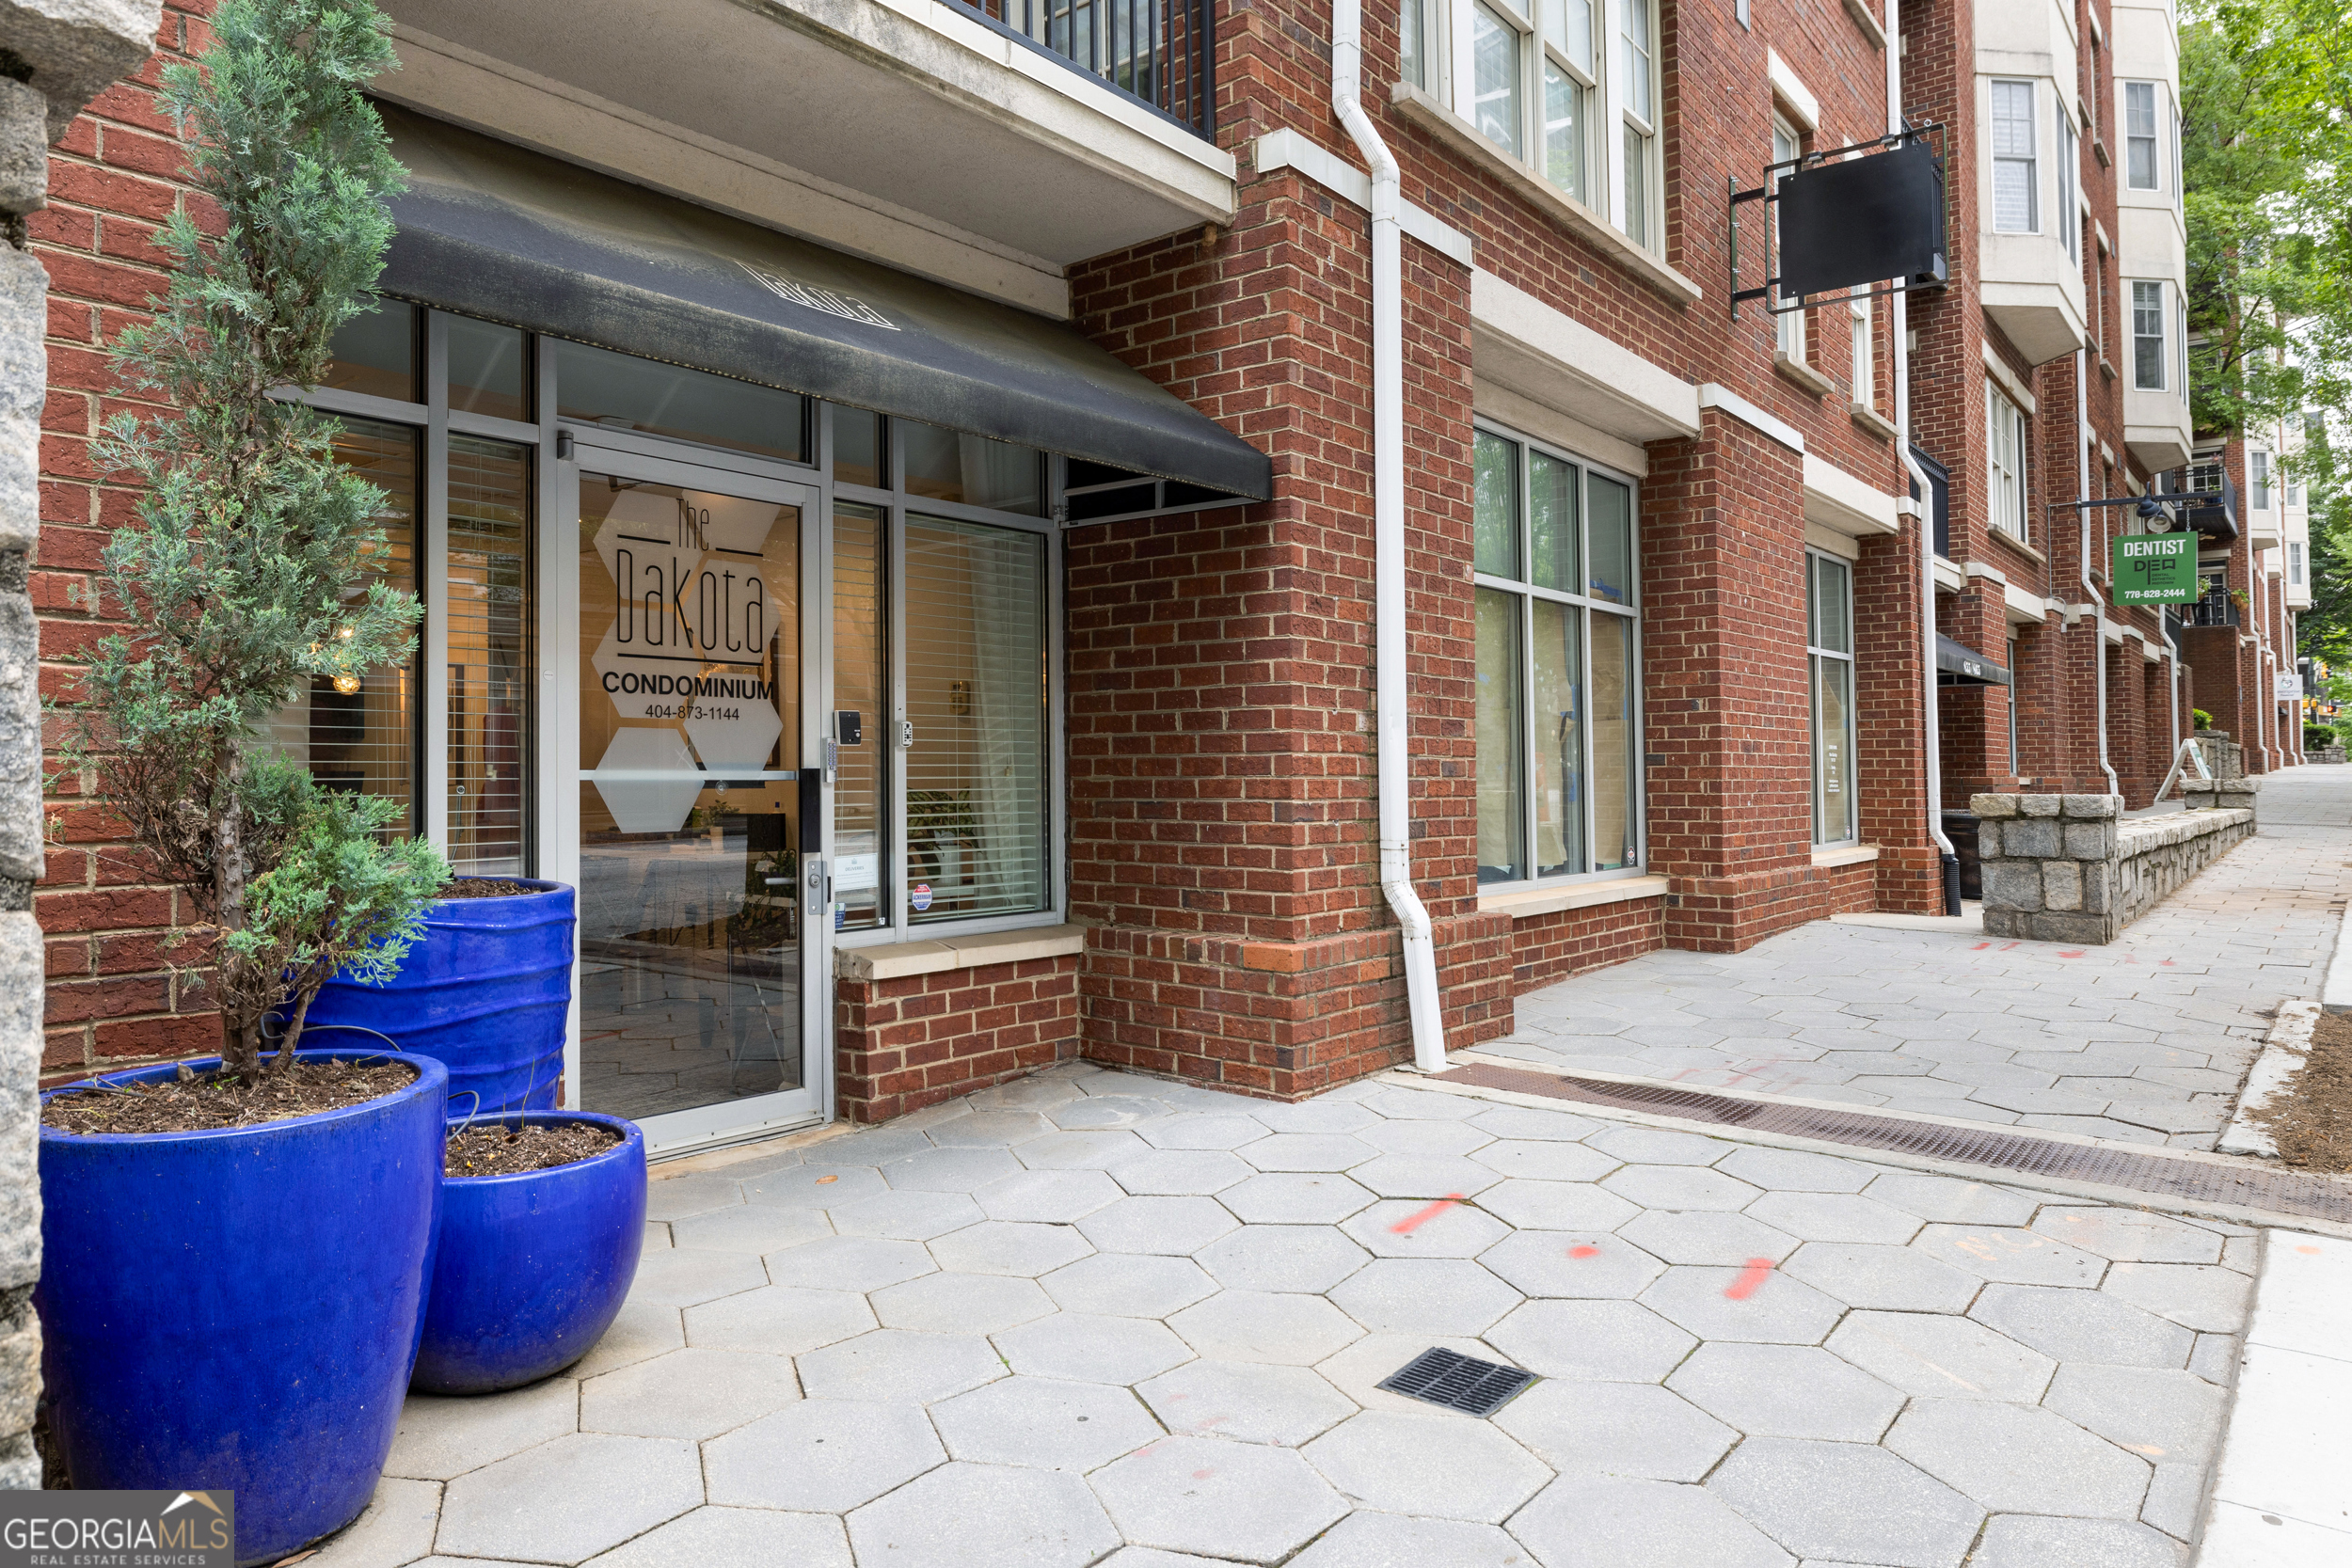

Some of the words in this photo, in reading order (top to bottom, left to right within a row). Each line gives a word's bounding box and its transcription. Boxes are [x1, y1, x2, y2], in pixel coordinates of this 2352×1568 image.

[675, 498, 709, 551] The
[2123, 539, 2186, 557] DENTIST
[616, 548, 763, 654] Dakota
[602, 672, 774, 700] CONDOMINIUM
[645, 705, 739, 721] 404-873-1144
